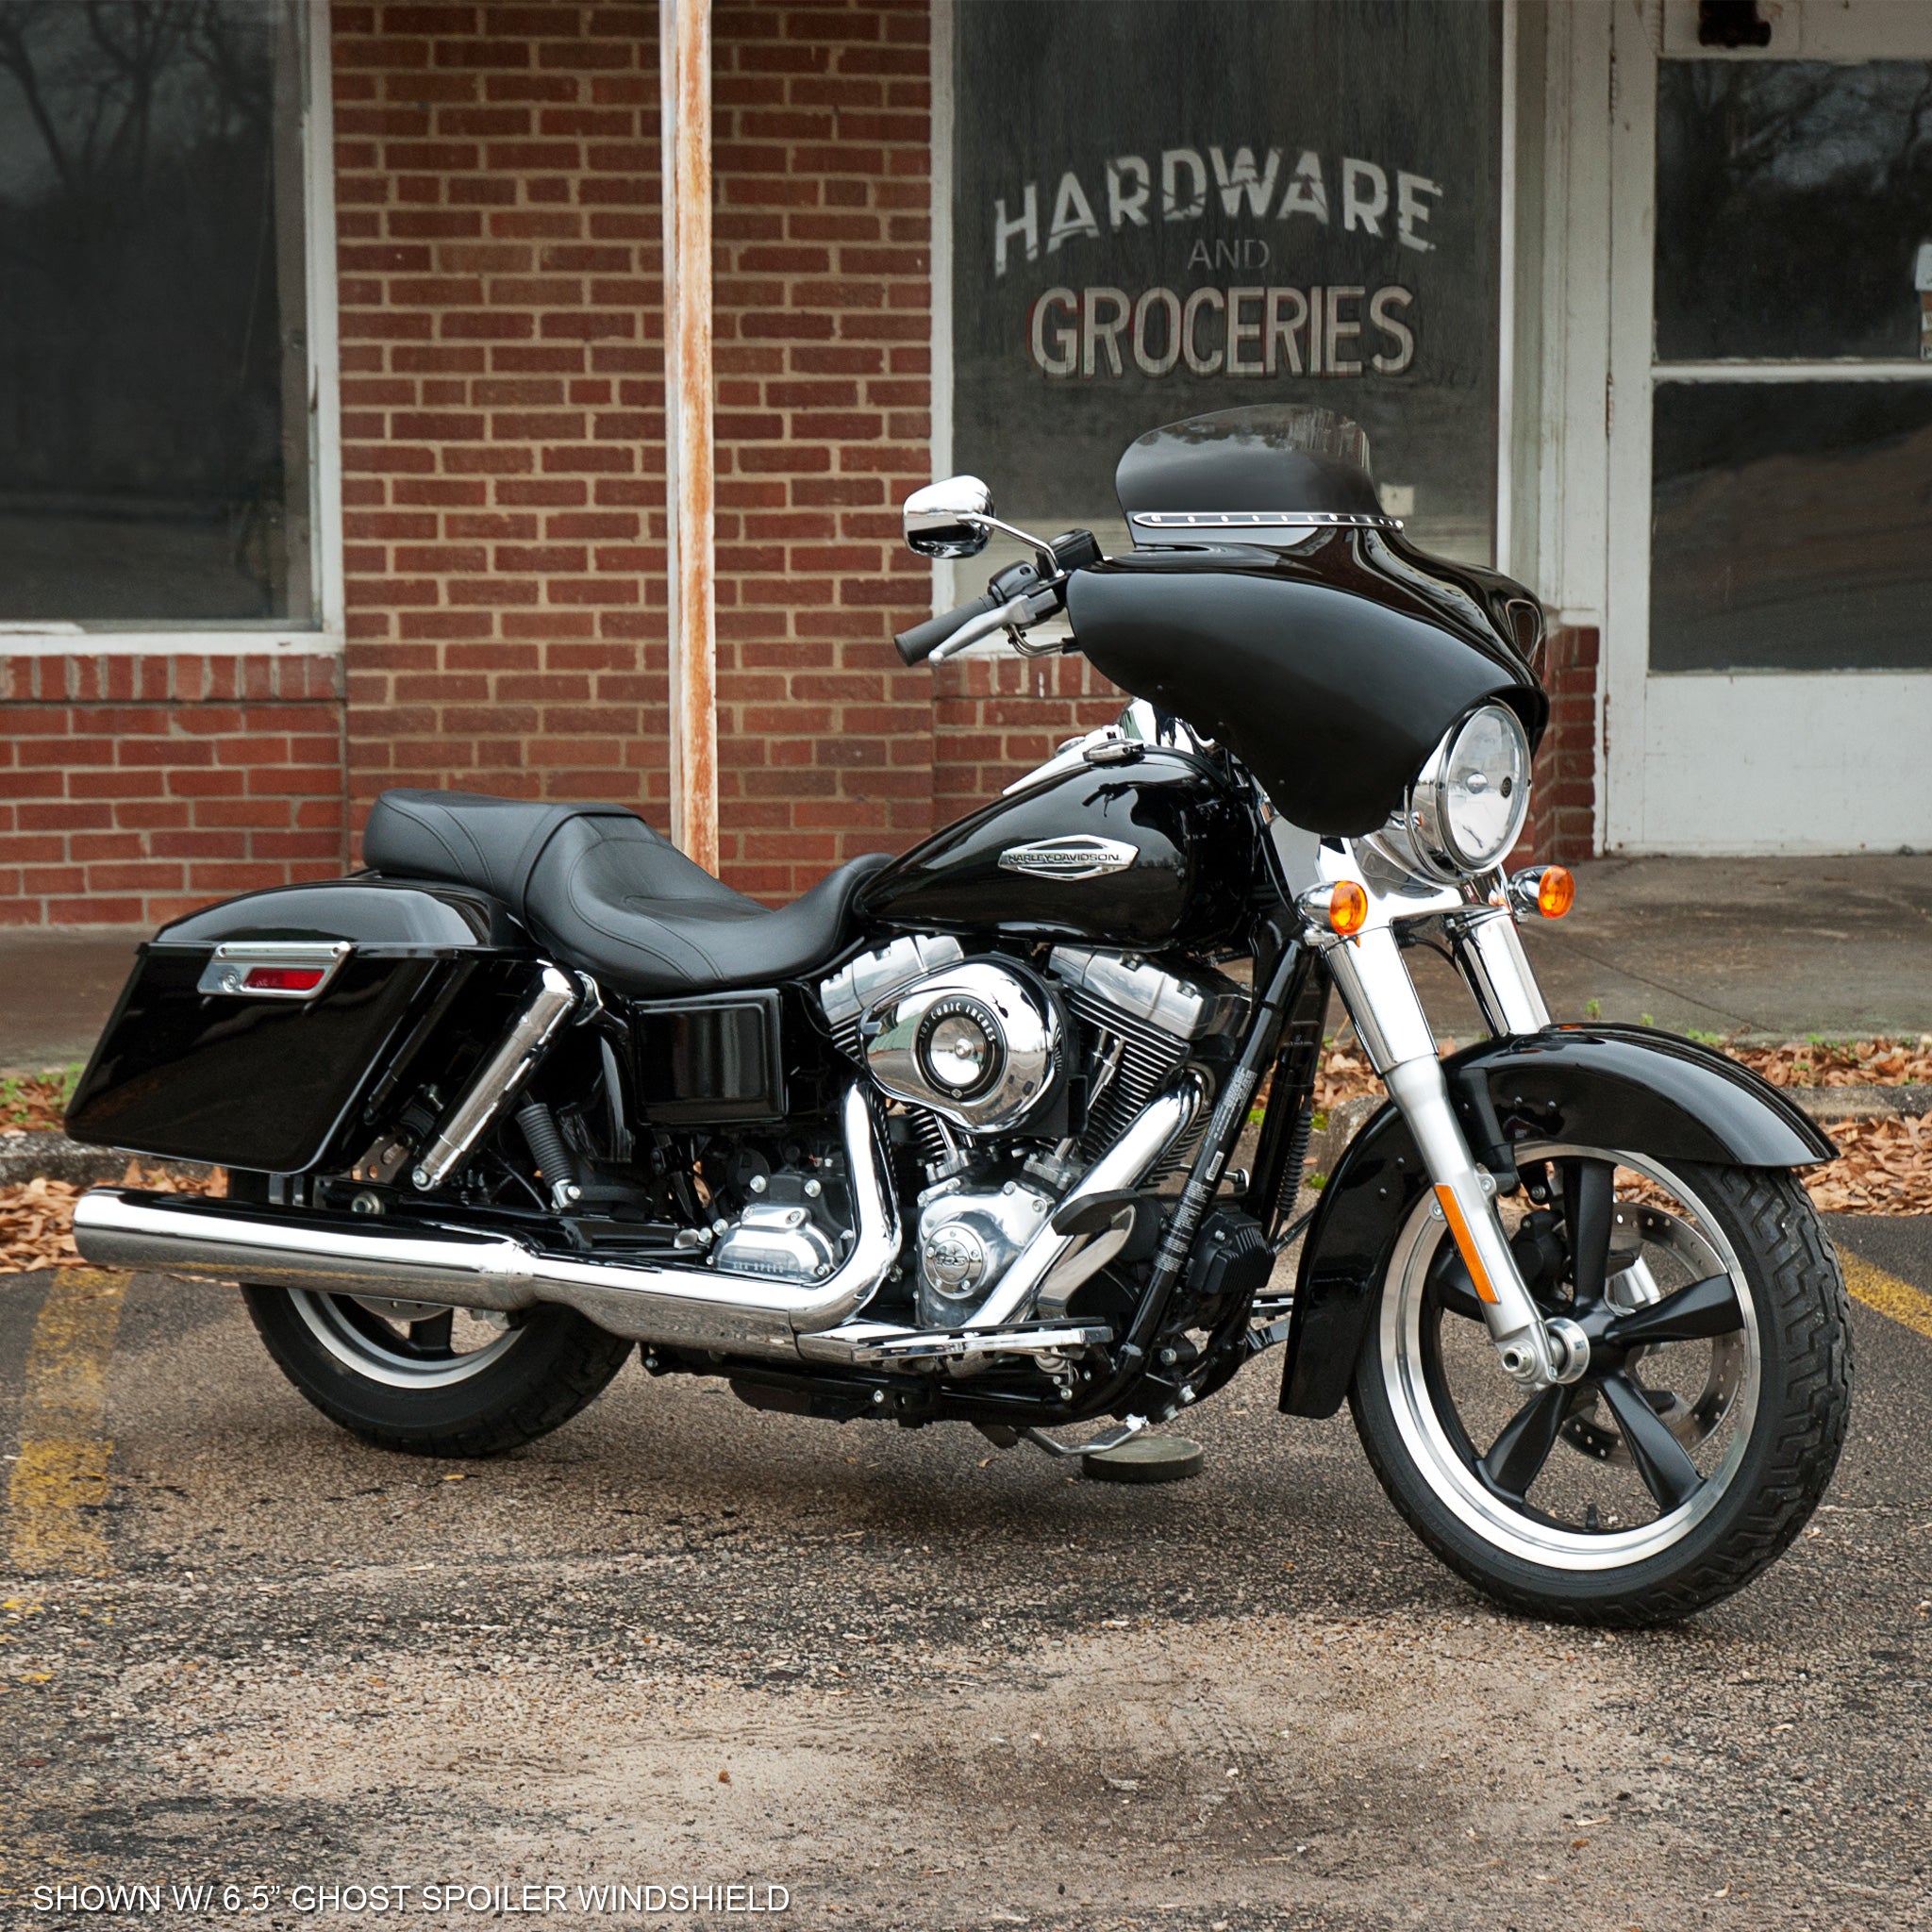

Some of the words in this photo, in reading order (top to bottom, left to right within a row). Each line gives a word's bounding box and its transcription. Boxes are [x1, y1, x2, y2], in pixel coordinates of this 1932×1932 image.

[994, 146, 1443, 277] HARDWARE
[1187, 238, 1270, 271] AND
[1026, 285, 1414, 376] GROCERIES
[1008, 853, 1120, 863] HARLEY-DAVIDSON
[930, 1002, 961, 1020] CUBIC
[965, 1005, 996, 1041] INCHES
